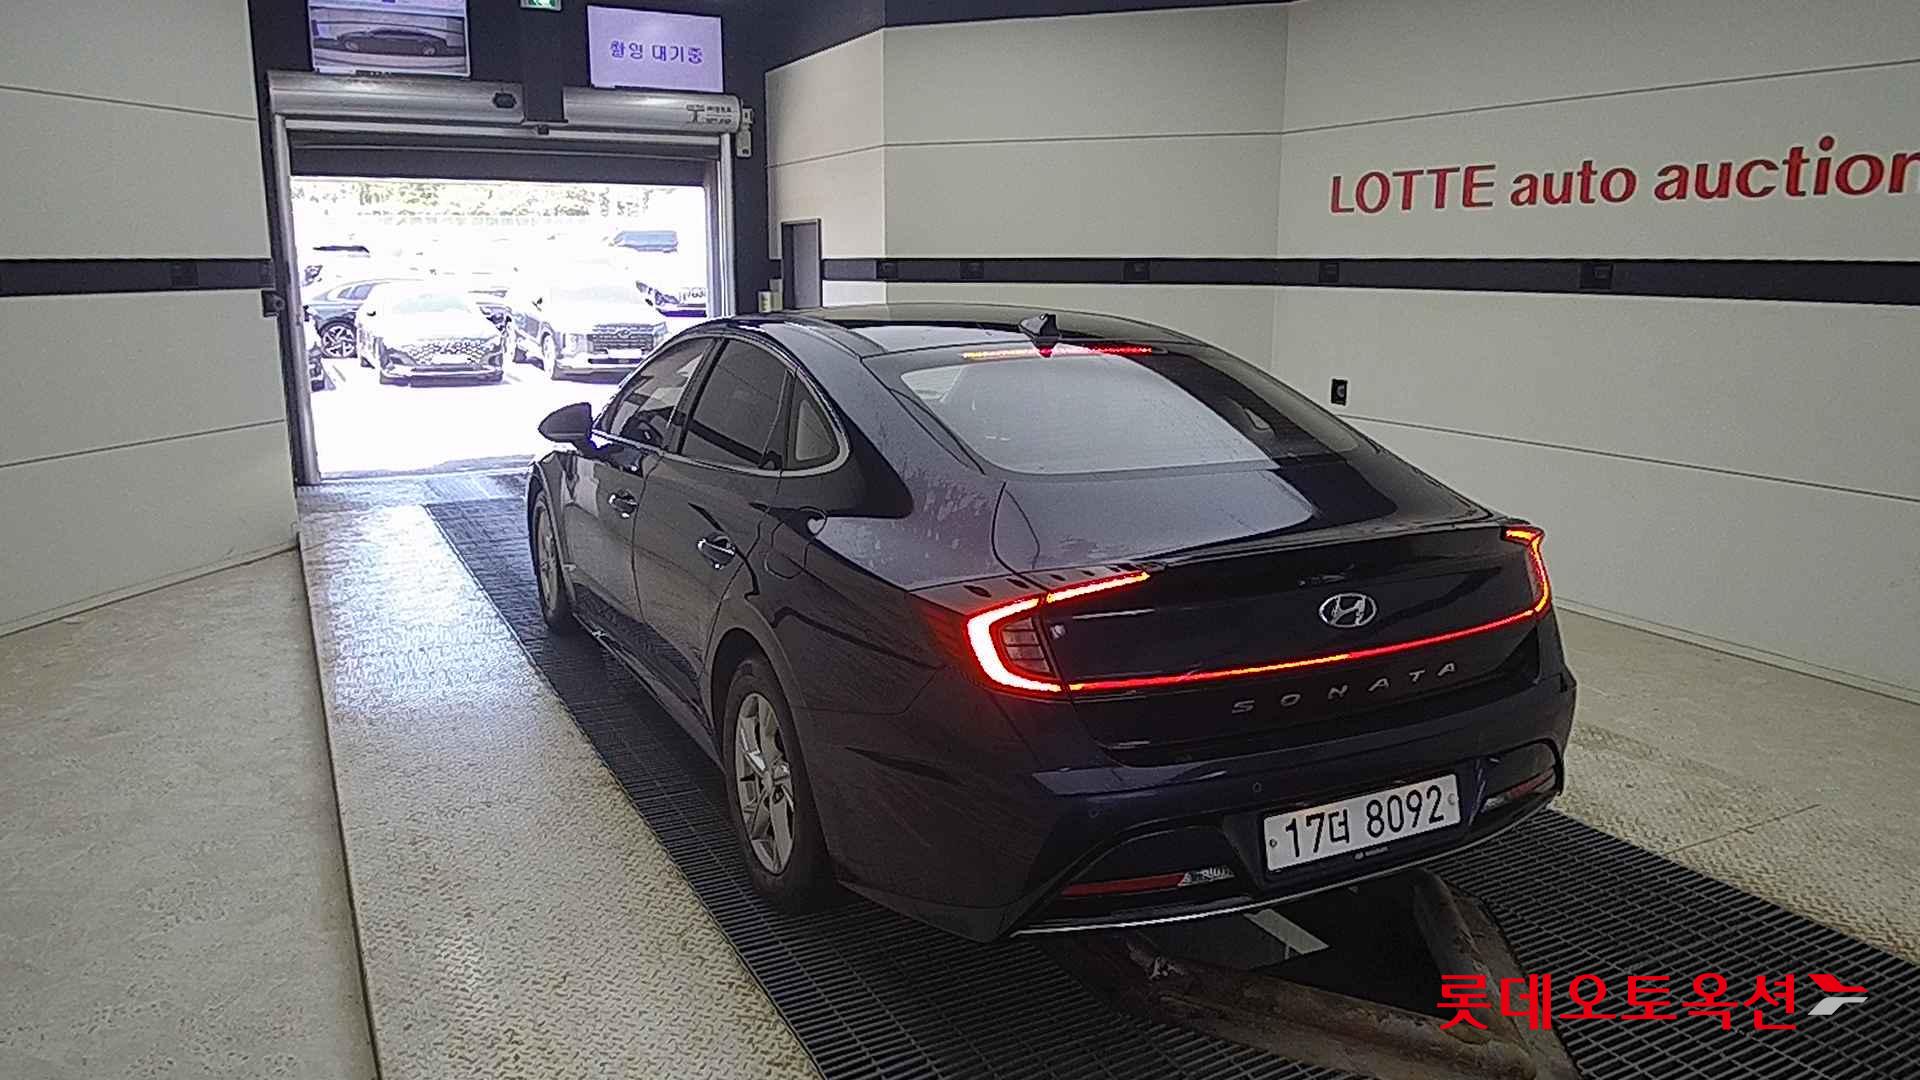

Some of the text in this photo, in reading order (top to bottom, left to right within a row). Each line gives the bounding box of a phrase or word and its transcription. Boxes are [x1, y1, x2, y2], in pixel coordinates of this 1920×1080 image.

[652, 44, 703, 64] 대기중
[1331, 164, 1494, 214] LOTTE
[1511, 160, 1637, 206] auto
[1232, 663, 1456, 713] SONATA
[1285, 785, 1445, 858] 17더 8092
